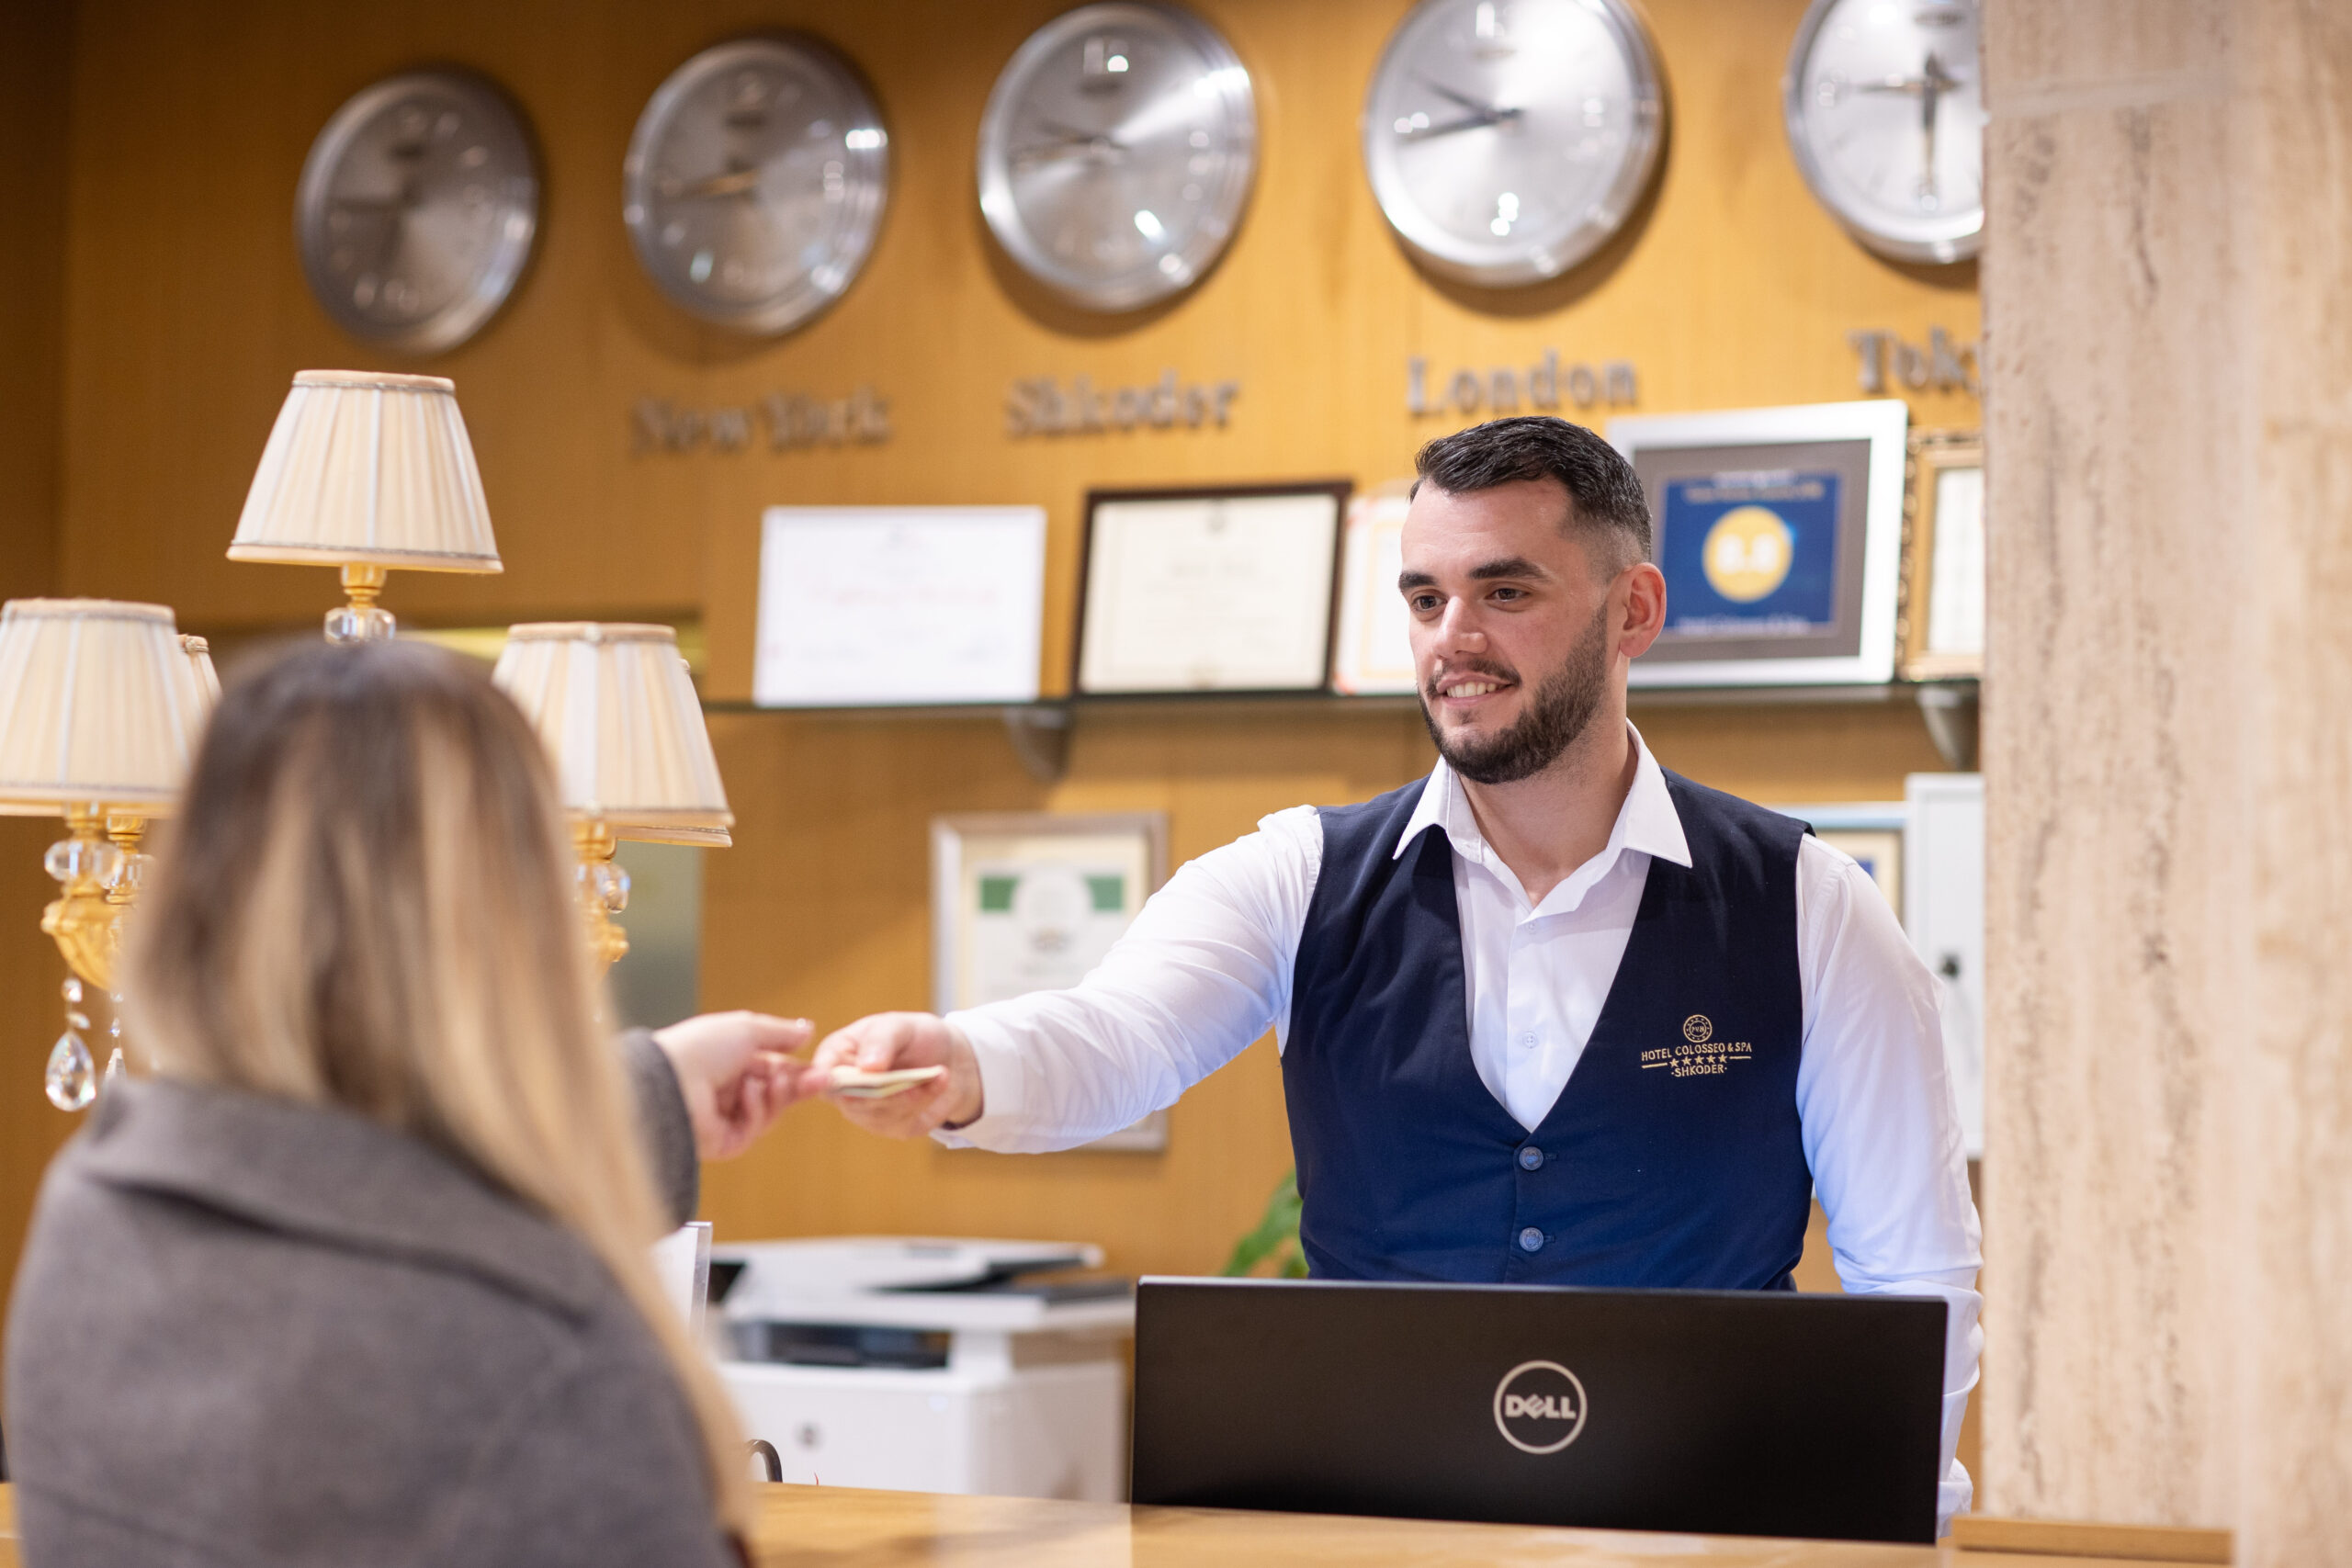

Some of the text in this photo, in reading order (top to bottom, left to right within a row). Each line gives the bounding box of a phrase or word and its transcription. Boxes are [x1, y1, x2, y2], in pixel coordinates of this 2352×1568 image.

[1006, 370, 1238, 438] Shkoder
[1408, 348, 1638, 415] London
[632, 388, 890, 453] New York
[1641, 1042, 1752, 1061] HOTEL COLOSSEO & SPA
[1505, 1393, 1577, 1420] DELL
